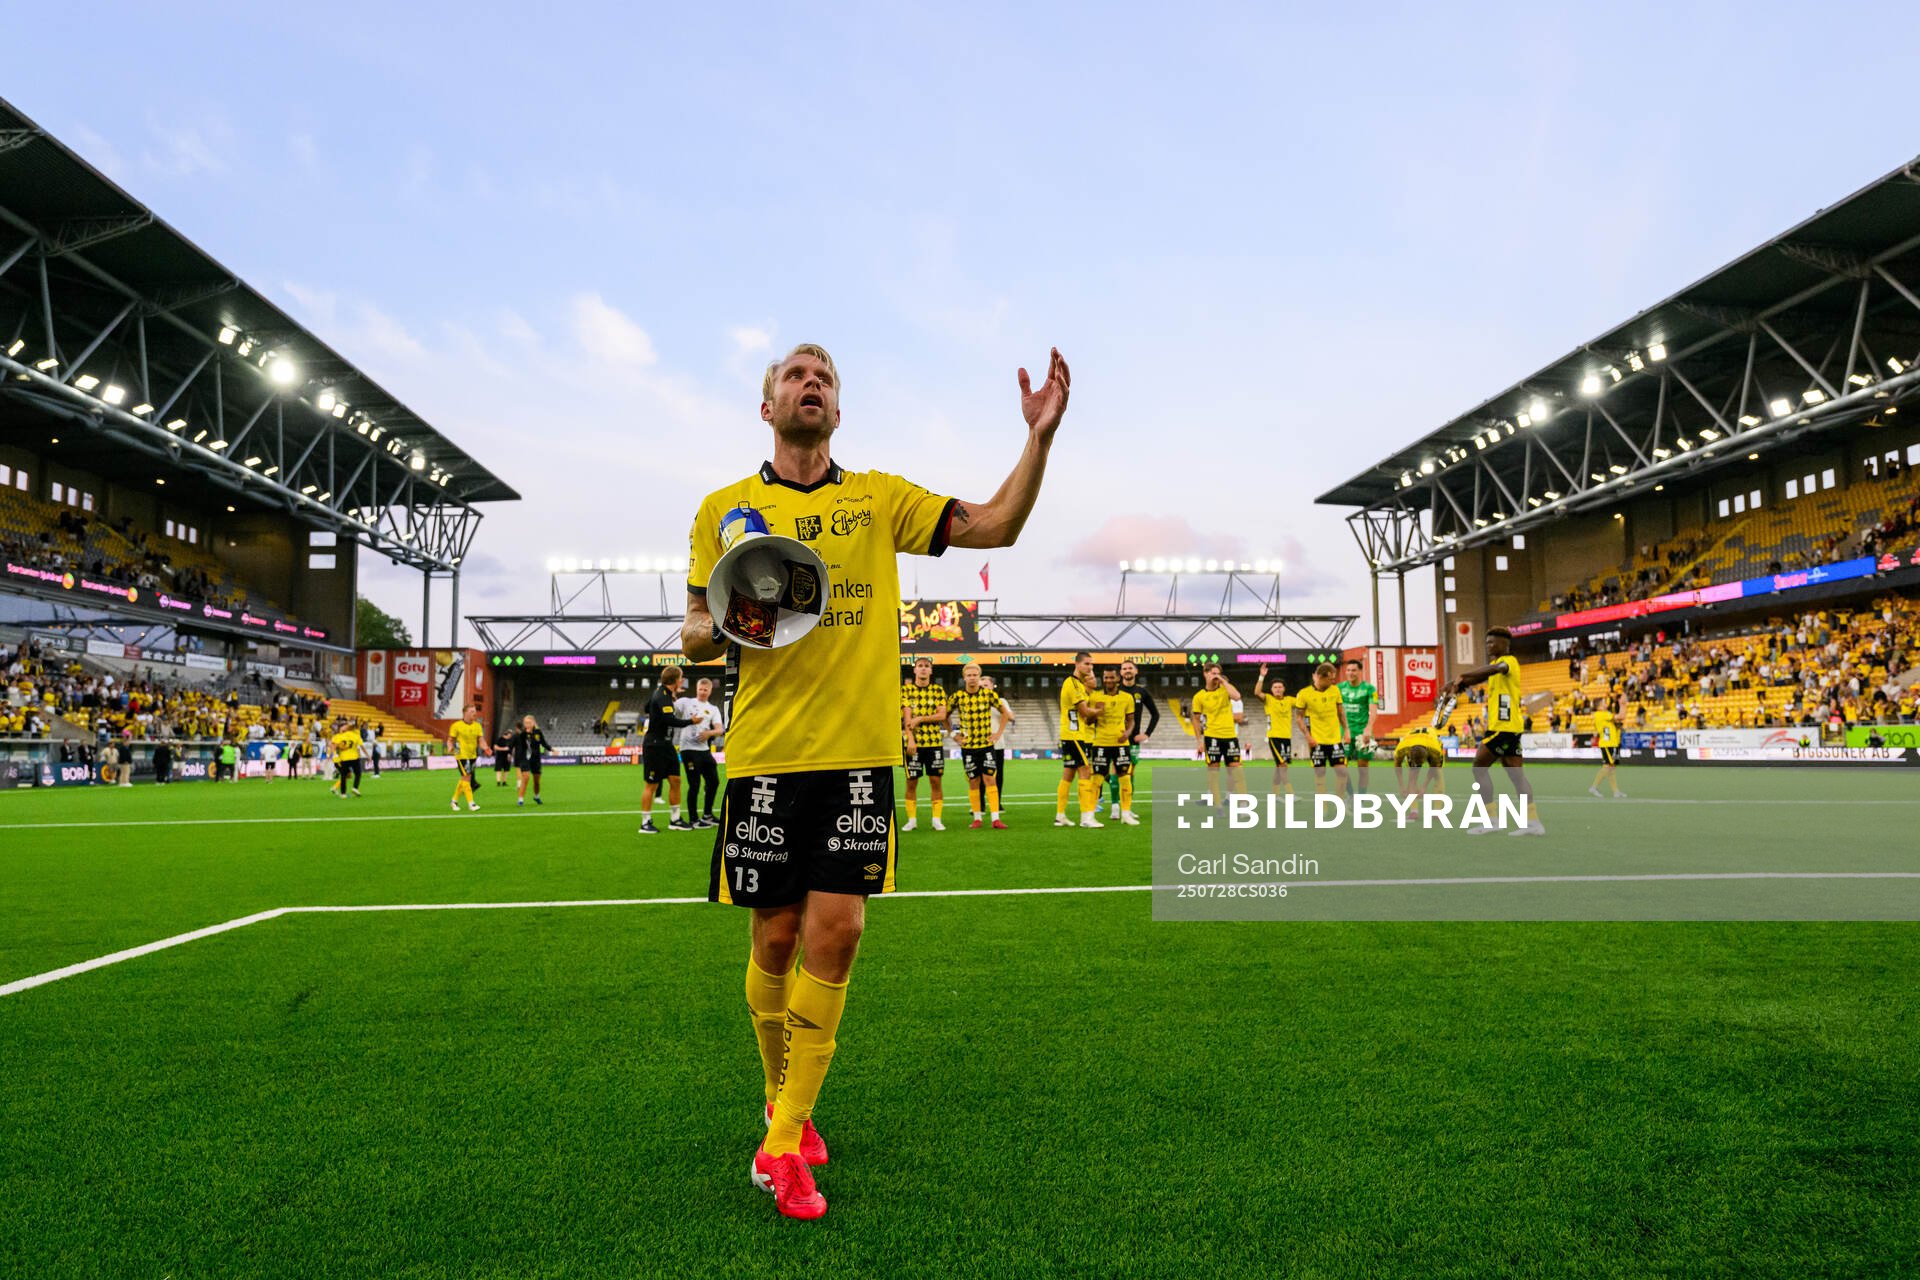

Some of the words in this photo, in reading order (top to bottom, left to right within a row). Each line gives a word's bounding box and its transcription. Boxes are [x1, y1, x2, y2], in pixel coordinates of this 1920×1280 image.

[831, 508, 873, 536] Elfsborg
[829, 578, 873, 599] nken
[818, 605, 864, 627] ärad
[656, 653, 698, 666] umbr
[1000, 652, 1042, 664] umbro
[1123, 652, 1165, 665] umbro
[582, 755, 631, 764] STADSPORTEN
[736, 816, 784, 845] ellos
[837, 808, 887, 833] ellos
[740, 846, 789, 863] Skrotfrag
[735, 866, 759, 893] 13
